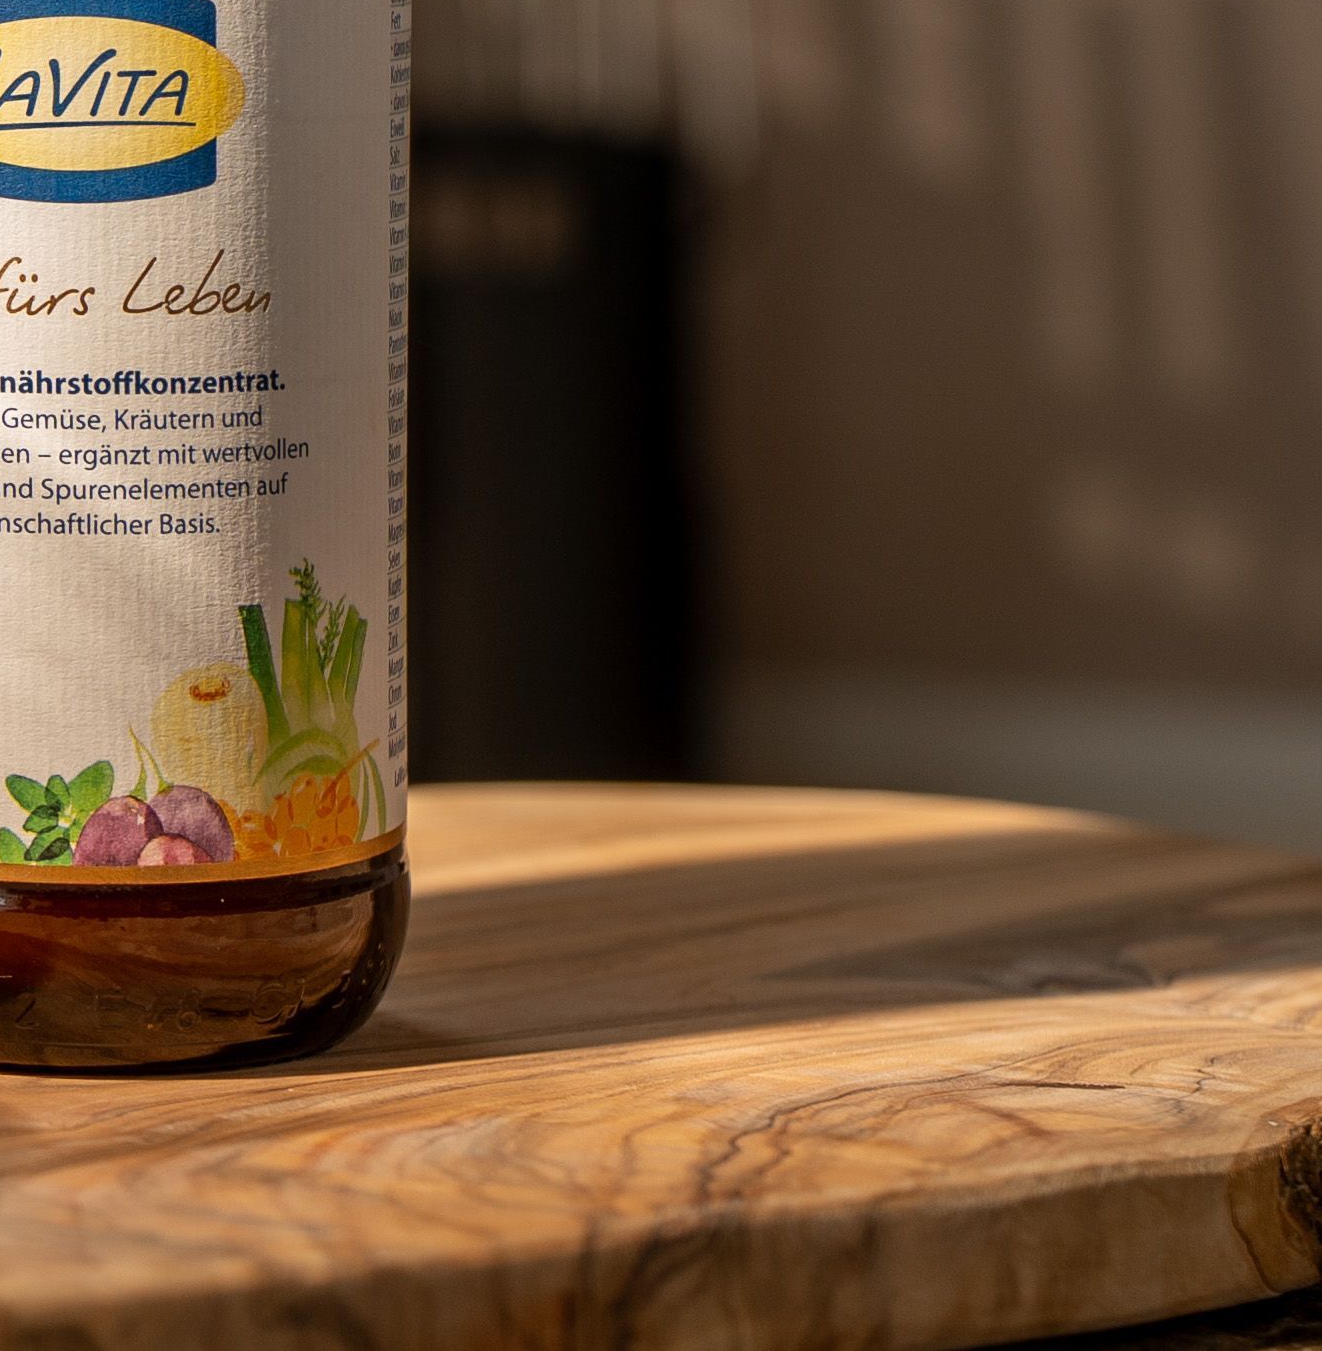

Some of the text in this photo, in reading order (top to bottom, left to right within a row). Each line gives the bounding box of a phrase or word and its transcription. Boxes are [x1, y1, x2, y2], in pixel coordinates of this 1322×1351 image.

[122, 249, 272, 315] Leben
[1, 407, 107, 435] Gemüse,
[114, 405, 215, 431] Kräutern
[222, 405, 264, 429] und
[58, 444, 151, 470] ergänzt
[158, 443, 197, 465] mit
[202, 439, 310, 463] wertvollen
[41, 476, 251, 505] Spurenelementen
[256, 468, 289, 496] auf
[159, 512, 221, 535] Basis.
